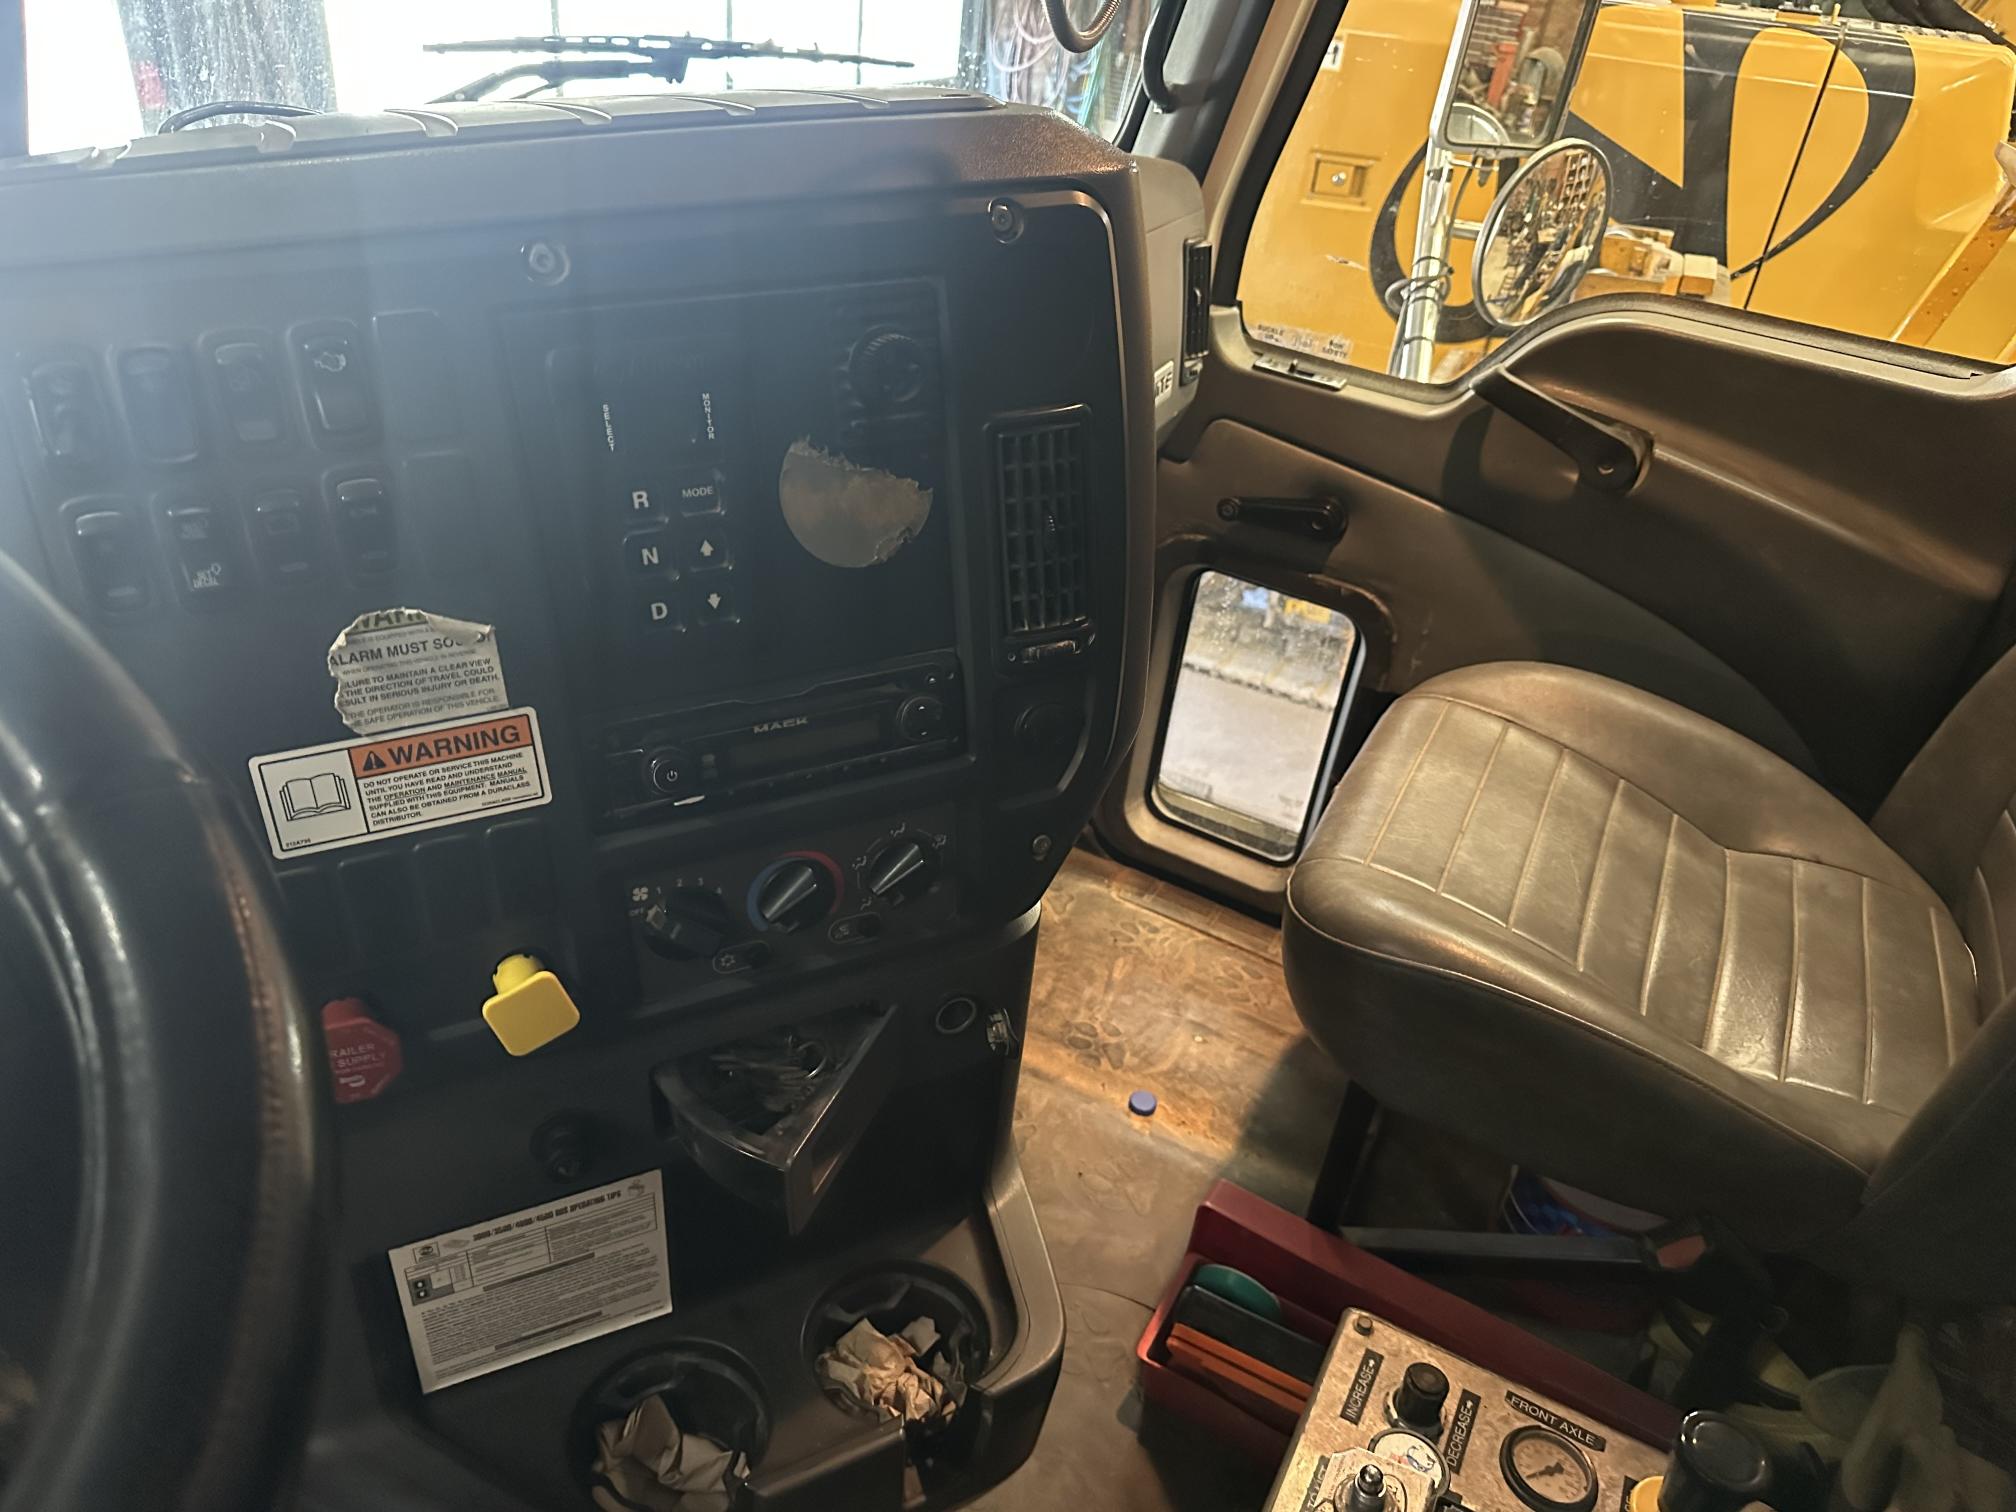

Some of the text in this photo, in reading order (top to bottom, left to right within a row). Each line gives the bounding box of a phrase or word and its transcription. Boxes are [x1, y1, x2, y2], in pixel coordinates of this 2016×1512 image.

[603, 404, 614, 452] SELECT
[702, 393, 714, 440] MONITOR
[632, 486, 713, 509] R MODE
[642, 547, 659, 566] N
[650, 602, 668, 620] D
[328, 648, 382, 667] ALARM
[387, 641, 429, 657] MUST
[345, 688, 362, 696] THE
[364, 679, 413, 693] DIRECTION
[428, 671, 461, 682] TRAVEL
[463, 665, 494, 676] COULD
[386, 668, 427, 681] MAINTAIN
[438, 661, 467, 672] CLEAR
[468, 657, 490, 667] VIEW
[380, 687, 419, 699] SERIOUS
[420, 681, 451, 692] INJURY
[454, 679, 467, 687] OR
[364, 715, 384, 724] SAFE
[386, 707, 432, 721] OPERATION
[754, 716, 808, 734] MACK
[386, 723, 520, 766] WARNING
[365, 761, 512, 795] UNTIL YOU HAVE READ AND UNDERSTAND
[393, 771, 426, 782] OPERATE
[441, 762, 472, 772] SERVICE
[473, 758, 489, 766] THIS
[490, 752, 522, 763] MACHINE
[368, 799, 405, 811] SUPPLIED
[406, 795, 424, 803] WITH
[425, 791, 441, 799] THIS
[489, 775, 523, 786] MANUALS
[370, 810, 386, 818] CAN
[388, 806, 408, 814] ALSO
[420, 795, 457, 807] OBTAINED
[459, 791, 480, 800] FROM
[487, 781, 530, 794] DURACLASS
[383, 787, 425, 800] OPERATION
[427, 783, 442, 791] AND
[443, 773, 495, 788] MAINTENANCE
[330, 1043, 376, 1057] RAILER
[606, 1190, 622, 1200] TIPS
[1346, 1364, 1375, 1419] INCREASE
[1511, 1396, 1597, 1444] FRONT AXLE
[1446, 1405, 1473, 1467] DECREASE
